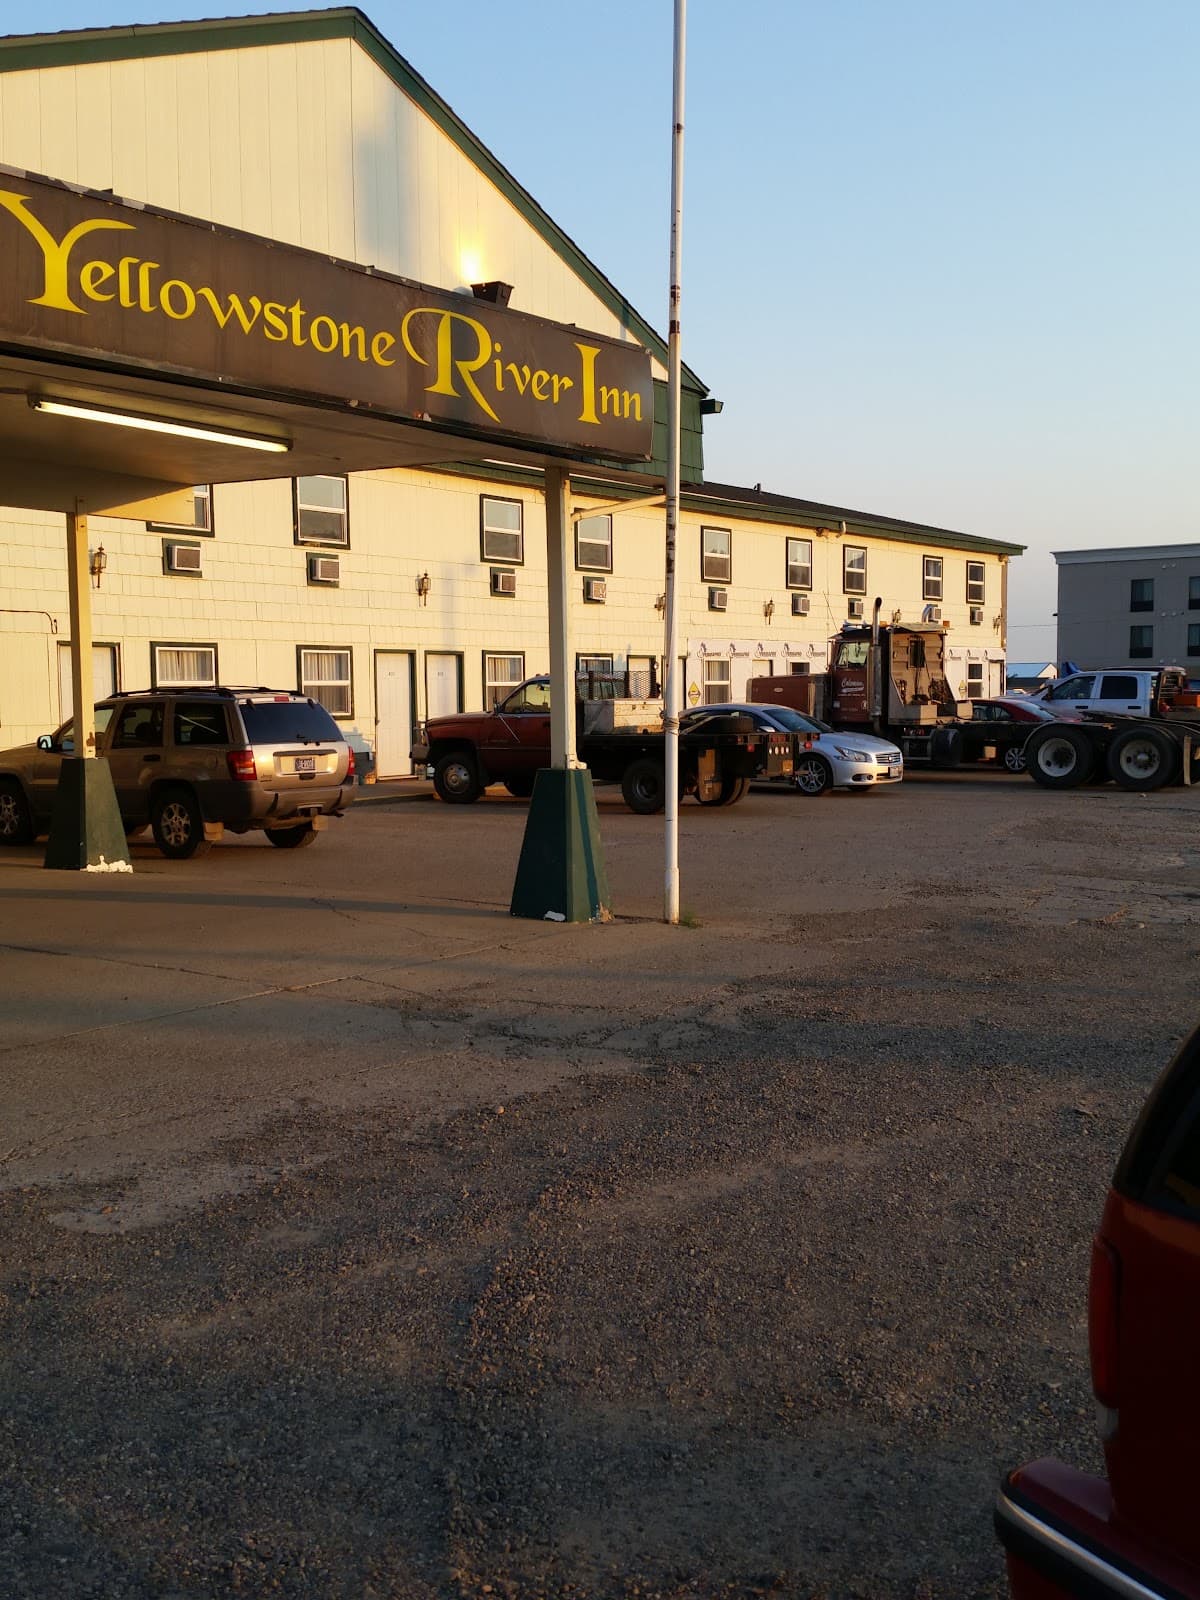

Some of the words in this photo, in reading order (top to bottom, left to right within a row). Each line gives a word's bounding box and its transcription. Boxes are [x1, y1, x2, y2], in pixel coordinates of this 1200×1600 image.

[0, 189, 396, 367] Yellowstone
[401, 307, 574, 423] River
[574, 343, 643, 425] Inn
